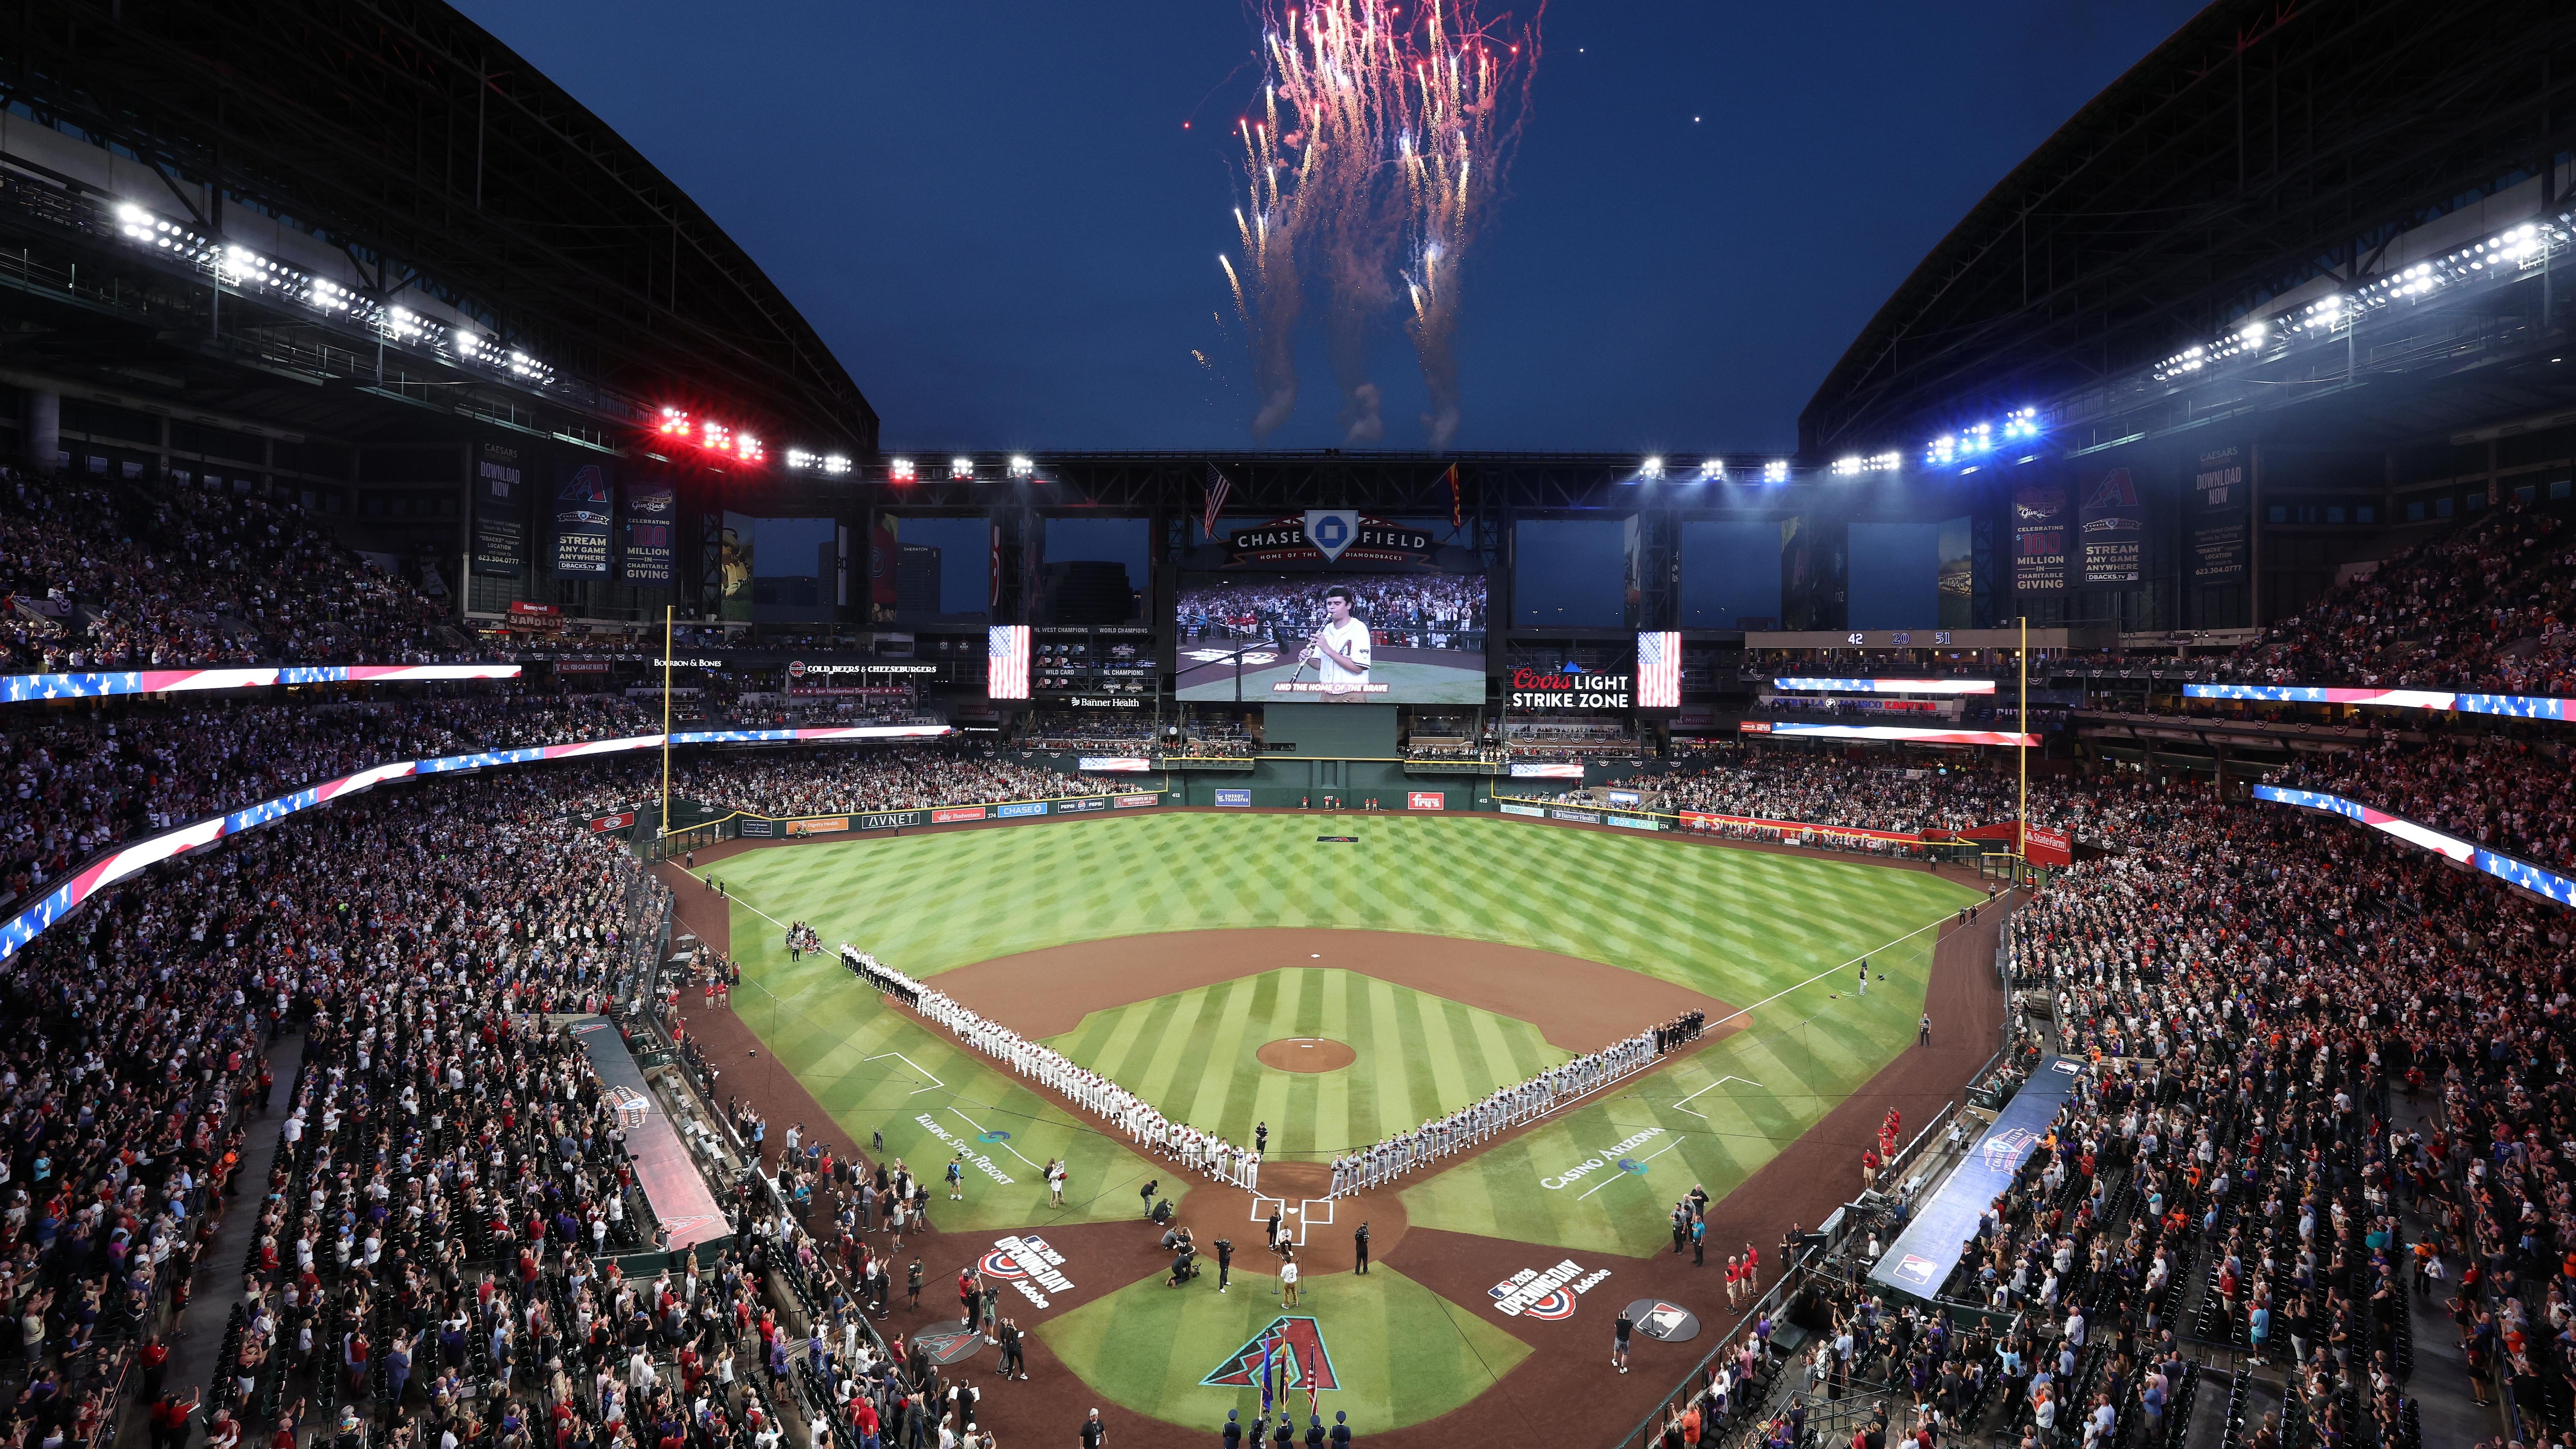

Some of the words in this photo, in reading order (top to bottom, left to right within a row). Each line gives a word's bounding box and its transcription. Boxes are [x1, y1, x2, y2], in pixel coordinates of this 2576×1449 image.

[484, 444, 517, 458] CAESARS
[2200, 447, 2238, 462] CAESARS
[480, 461, 520, 484] DOWNLOAD
[2197, 467, 2241, 490] DOWNLOAD
[492, 480, 509, 498] NOW
[2209, 487, 2228, 505] NOW
[632, 501, 647, 510] Give
[647, 502, 666, 511] Back
[2021, 508, 2038, 518] Give
[559, 536, 606, 546] STREAM
[1238, 531, 1300, 548] CHASE
[1363, 532, 1425, 548] FIELD
[627, 547, 669, 556] MILLION
[1345, 552, 1402, 561] DIAMONDBACKS
[2086, 545, 2138, 555] STREAM
[478, 554, 519, 565] 623.304.0777
[559, 553, 606, 561] ANYWHERE
[2017, 556, 2064, 565] MILLION
[626, 570, 669, 579] GIVING
[2195, 564, 2242, 575] 623.304.0777
[2017, 579, 2064, 589] GIVING
[523, 604, 547, 612] Honeywell
[509, 615, 562, 627] SANDLOT
[1848, 633, 1863, 644] 42
[1892, 633, 1909, 644] 20
[1935, 632, 1951, 644] 51
[699, 659, 721, 667] BONES
[1513, 668, 1571, 689] Coors
[1574, 676, 1629, 690] LIGHT
[1081, 698, 1111, 707] Banner
[1112, 698, 1139, 707] Health
[1513, 693, 1573, 707] STRIKE
[1579, 693, 1629, 708] ZONE
[1412, 794, 1440, 807] fry's
[1004, 806, 1032, 815] CHASE
[869, 813, 914, 826] AVNET
[617, 1089, 632, 1101] CHASE
[630, 1110, 639, 1123] FIELD
[1992, 1152, 2005, 1167] CHASE
[2006, 1132, 2023, 1144] FIELD
[1038, 1248, 1066, 1266] 2026
[994, 1235, 1053, 1276] OPENING
[1034, 1269, 1075, 1294] DAY
[1509, 1268, 1538, 1286] 2026
[1572, 1268, 1612, 1295] Adobe
[1494, 1274, 1563, 1317] OPENING
[1545, 1258, 1585, 1283] DAY
[1011, 1280, 1049, 1309] Adobe
